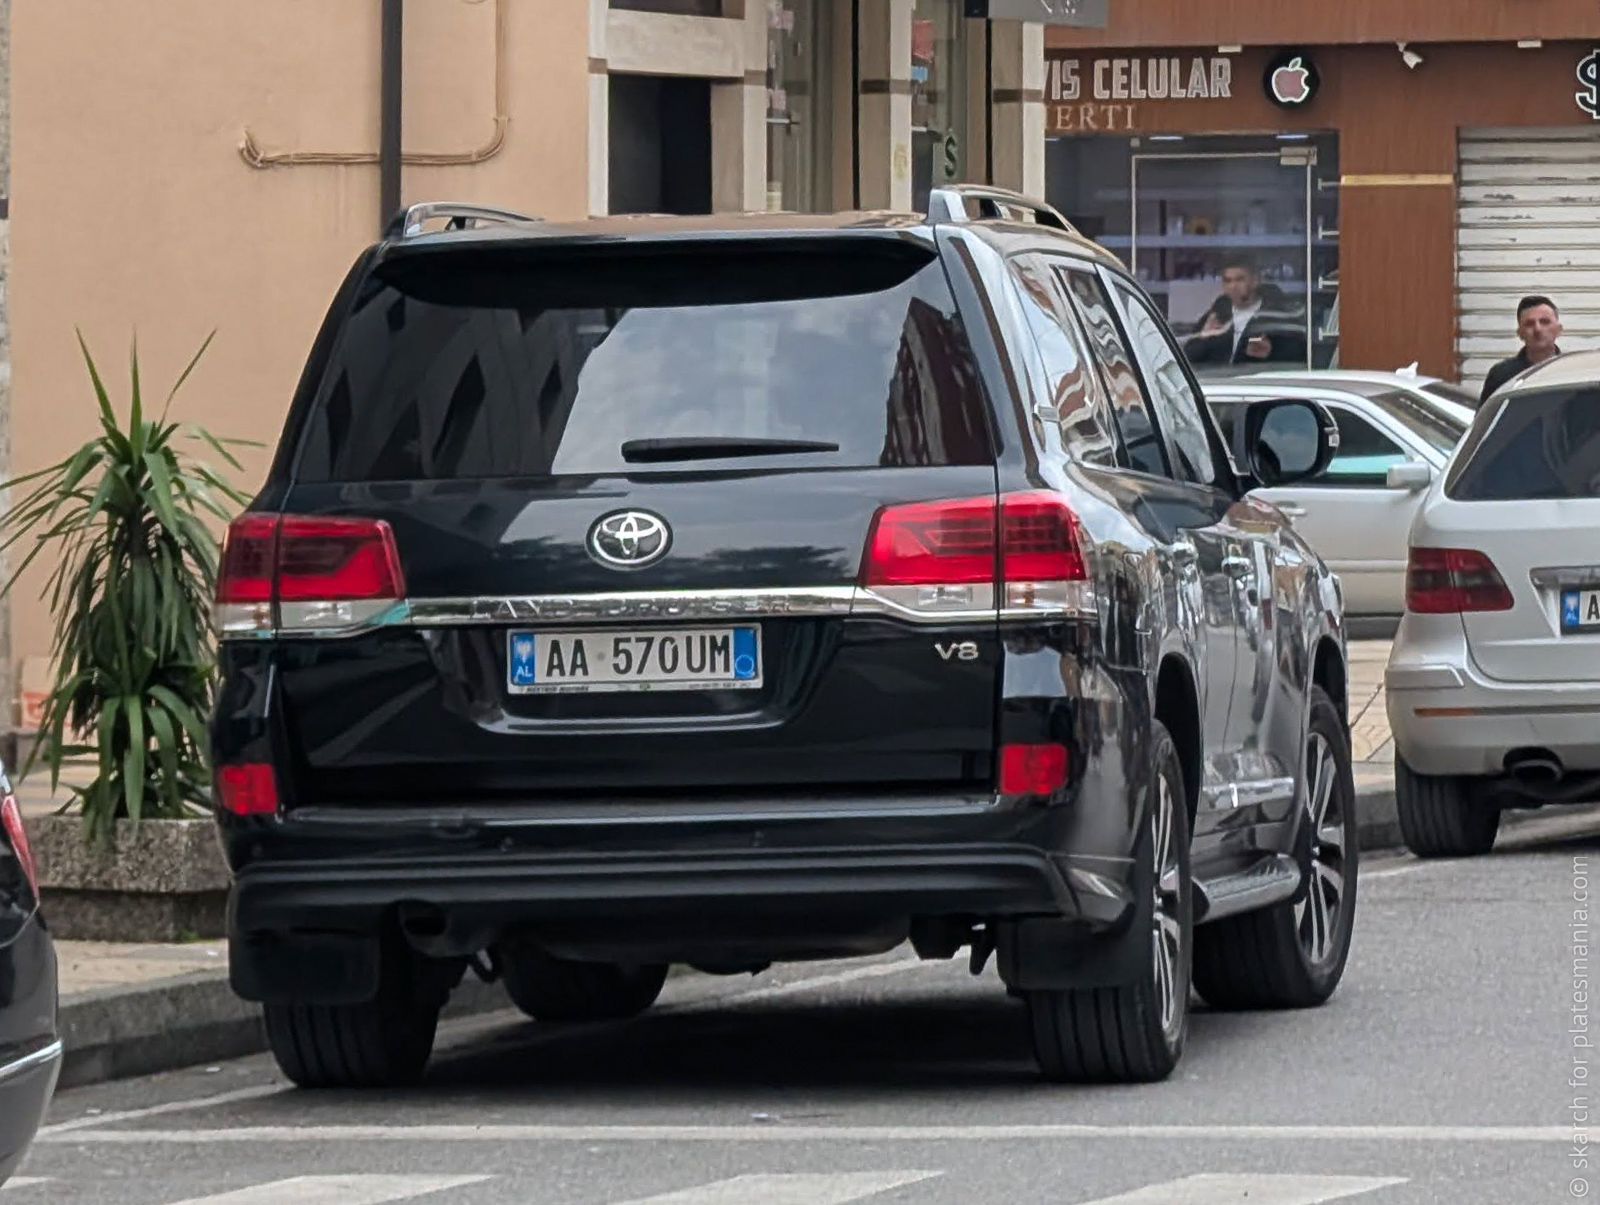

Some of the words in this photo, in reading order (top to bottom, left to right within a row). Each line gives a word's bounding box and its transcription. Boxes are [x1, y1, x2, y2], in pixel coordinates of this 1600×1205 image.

[1093, 57, 1232, 99] CELULAR
[1044, 103, 1137, 130] ERTI
[546, 639, 589, 677] AA
[934, 641, 979, 660] V8
[516, 665, 533, 677] AL
